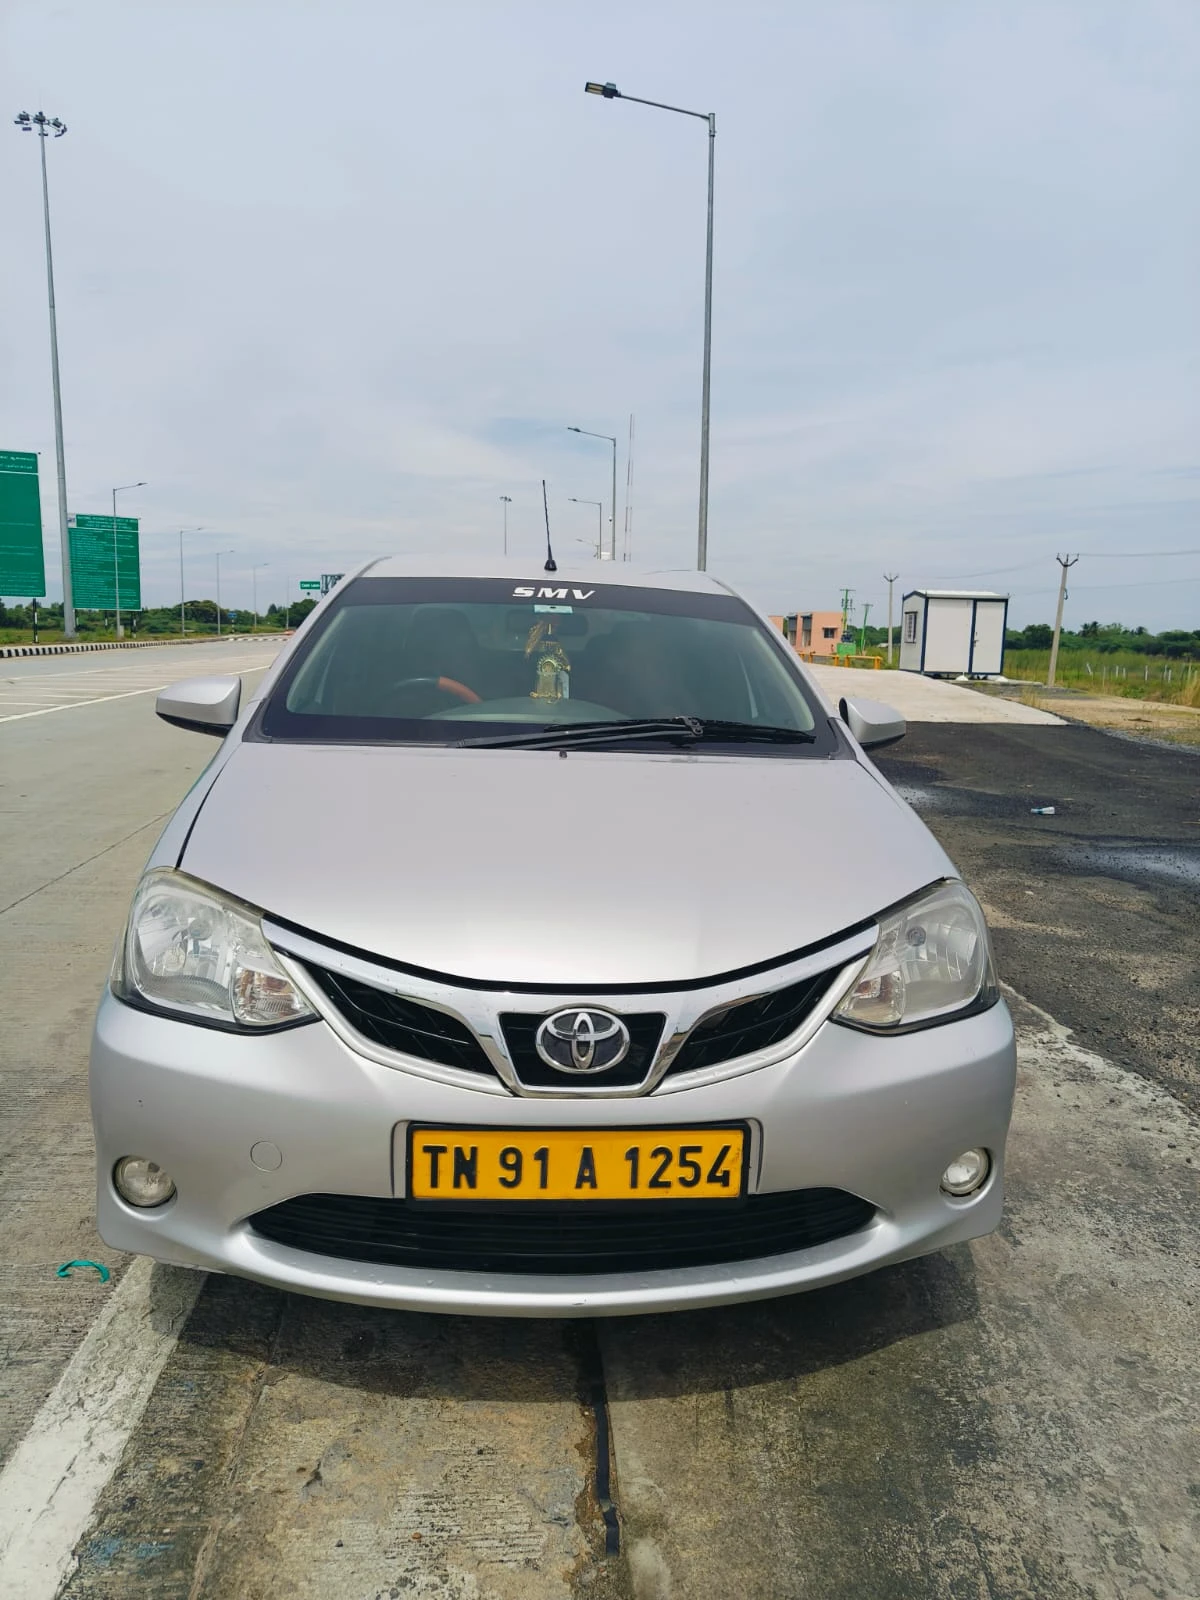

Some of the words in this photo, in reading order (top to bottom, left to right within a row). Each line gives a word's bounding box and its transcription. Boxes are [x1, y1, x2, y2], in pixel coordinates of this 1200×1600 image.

[512, 586, 597, 600] SMV
[422, 1145, 479, 1189] TN
[497, 1145, 550, 1189] 91
[574, 1146, 598, 1189] A
[624, 1144, 732, 1189] 1254
